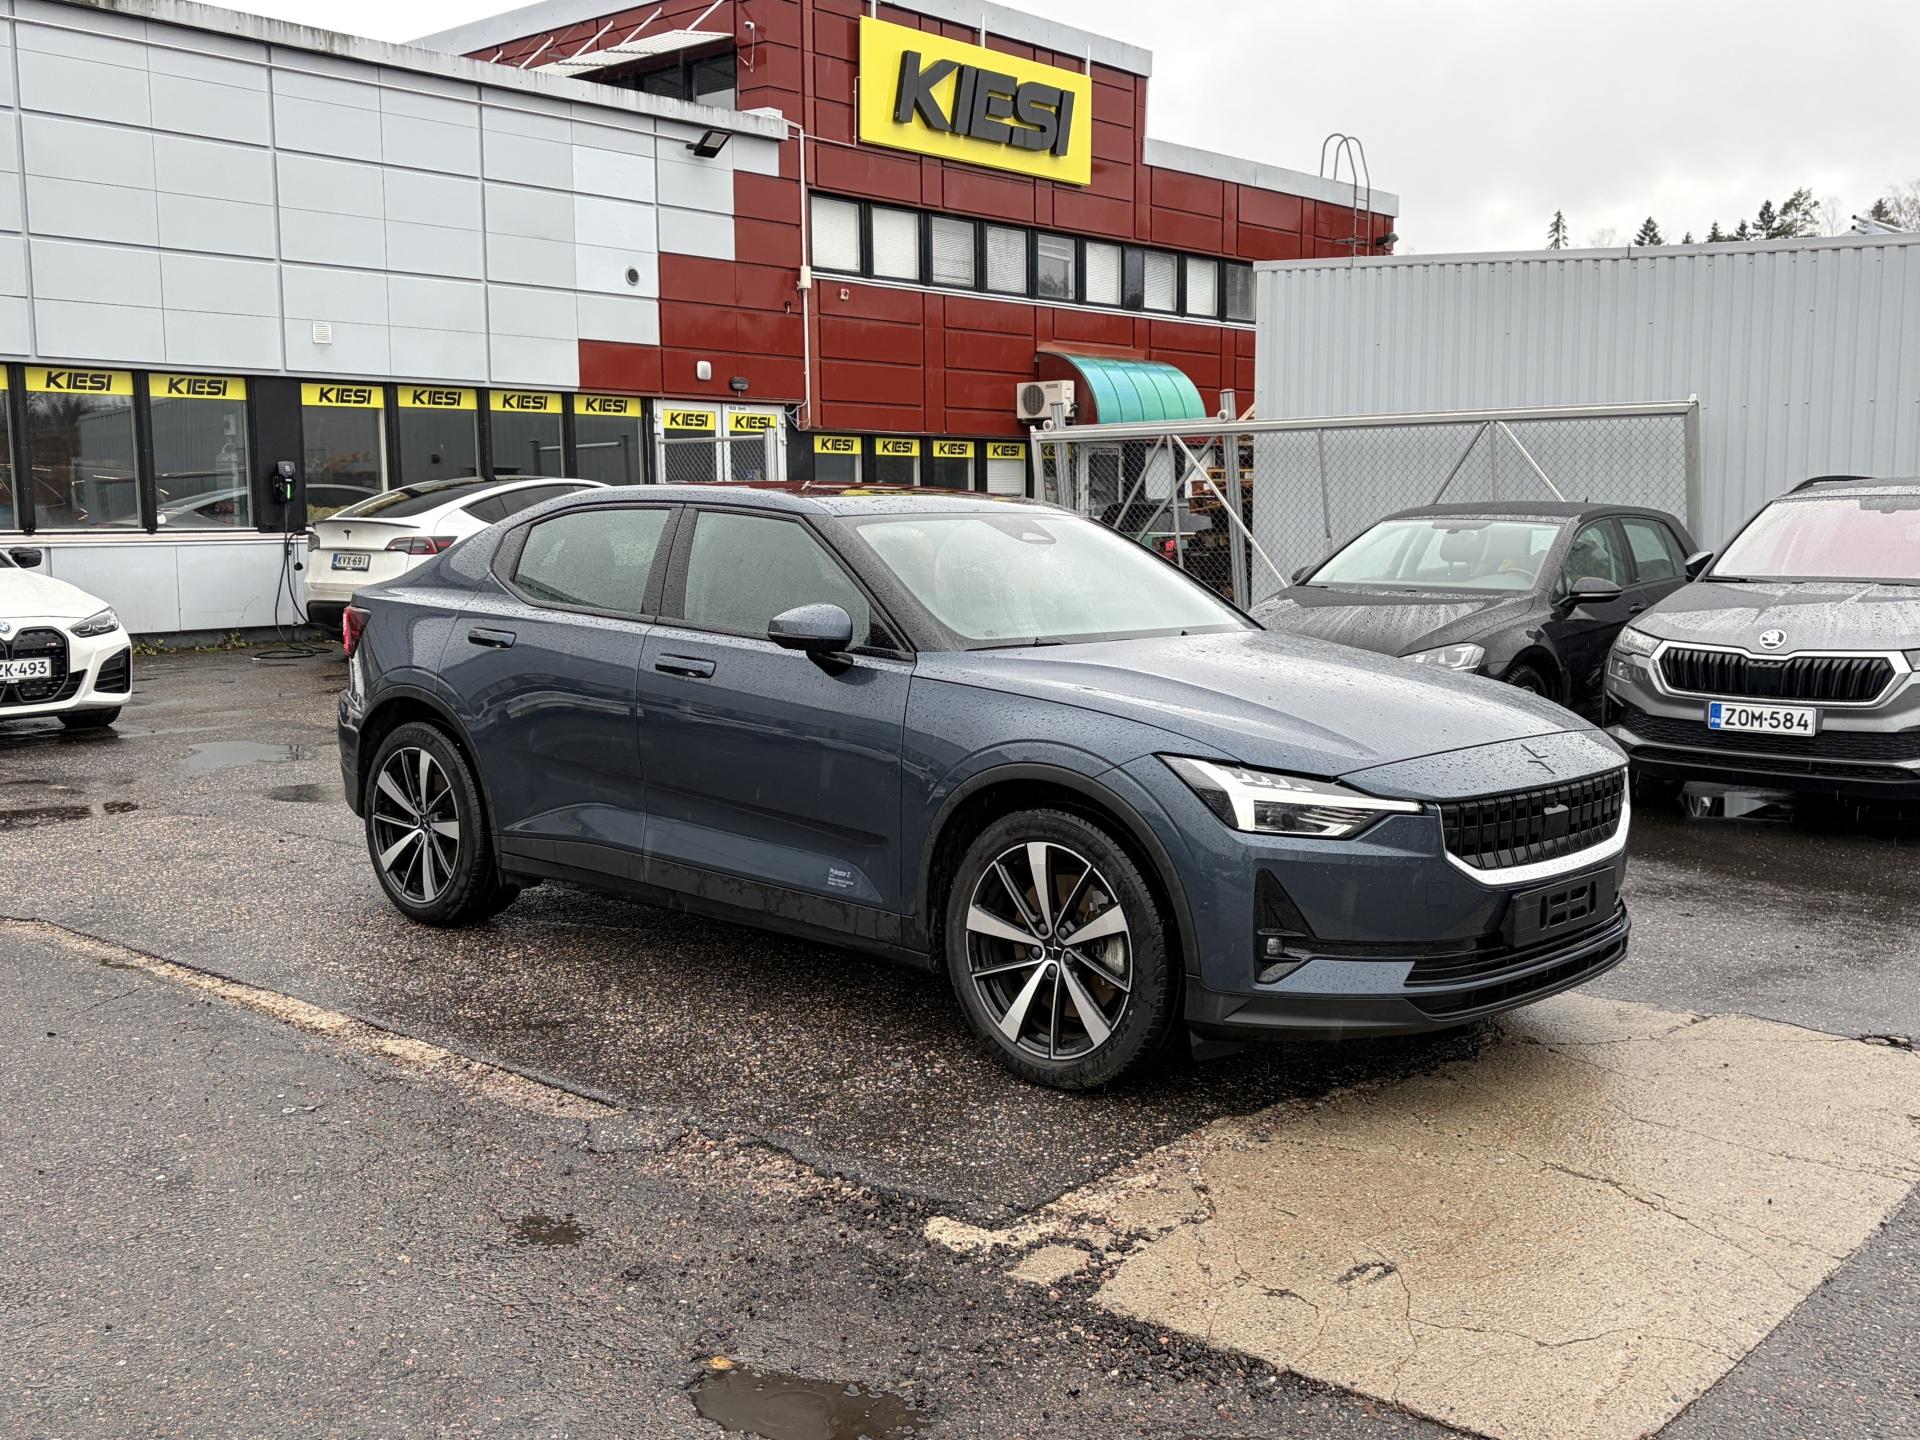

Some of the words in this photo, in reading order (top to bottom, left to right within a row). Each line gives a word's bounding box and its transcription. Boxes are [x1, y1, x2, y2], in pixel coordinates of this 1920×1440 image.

[894, 50, 1076, 157] KIESI
[46, 371, 112, 391] KIESI
[167, 377, 228, 397] KIESI
[319, 387, 372, 405] KIESI
[412, 389, 462, 407] KIESI
[503, 394, 548, 410] KIESI
[585, 398, 628, 413] KIESI
[669, 413, 708, 427] KIESI
[821, 438, 854, 452] KIESI
[882, 441, 913, 454] KIESI
[939, 443, 968, 456] KIESI
[992, 445, 1020, 457] KIESI
[1725, 708, 1809, 731] ZOM-584
